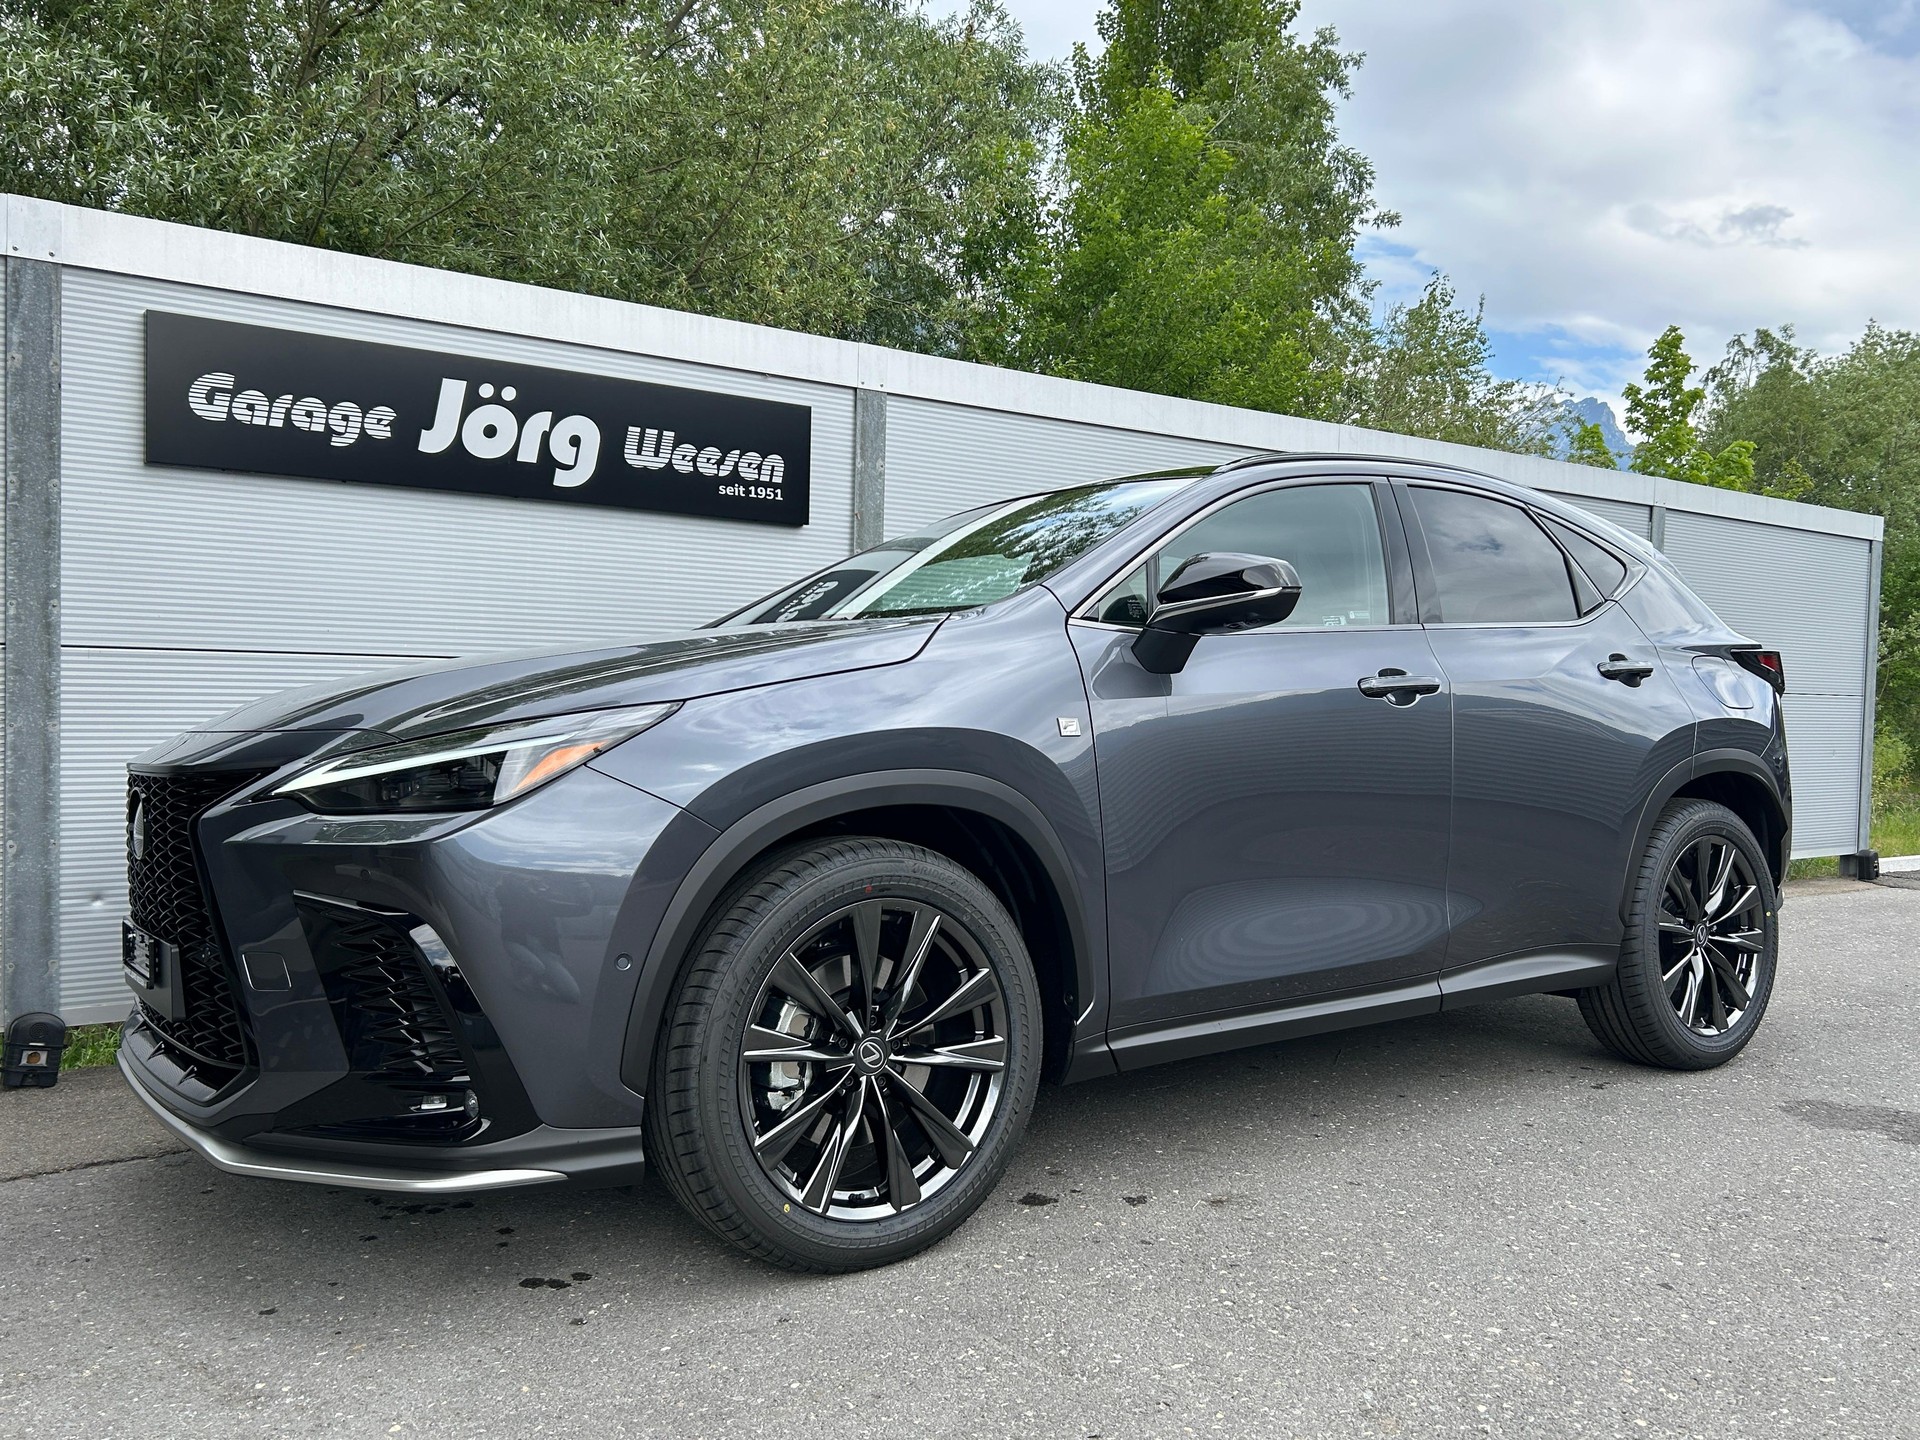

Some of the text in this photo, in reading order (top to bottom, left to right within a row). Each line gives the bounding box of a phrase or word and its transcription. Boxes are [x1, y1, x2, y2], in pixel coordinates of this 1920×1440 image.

[189, 373, 785, 488] Garage Jörg Weesen
[718, 484, 784, 501] seit 1951
